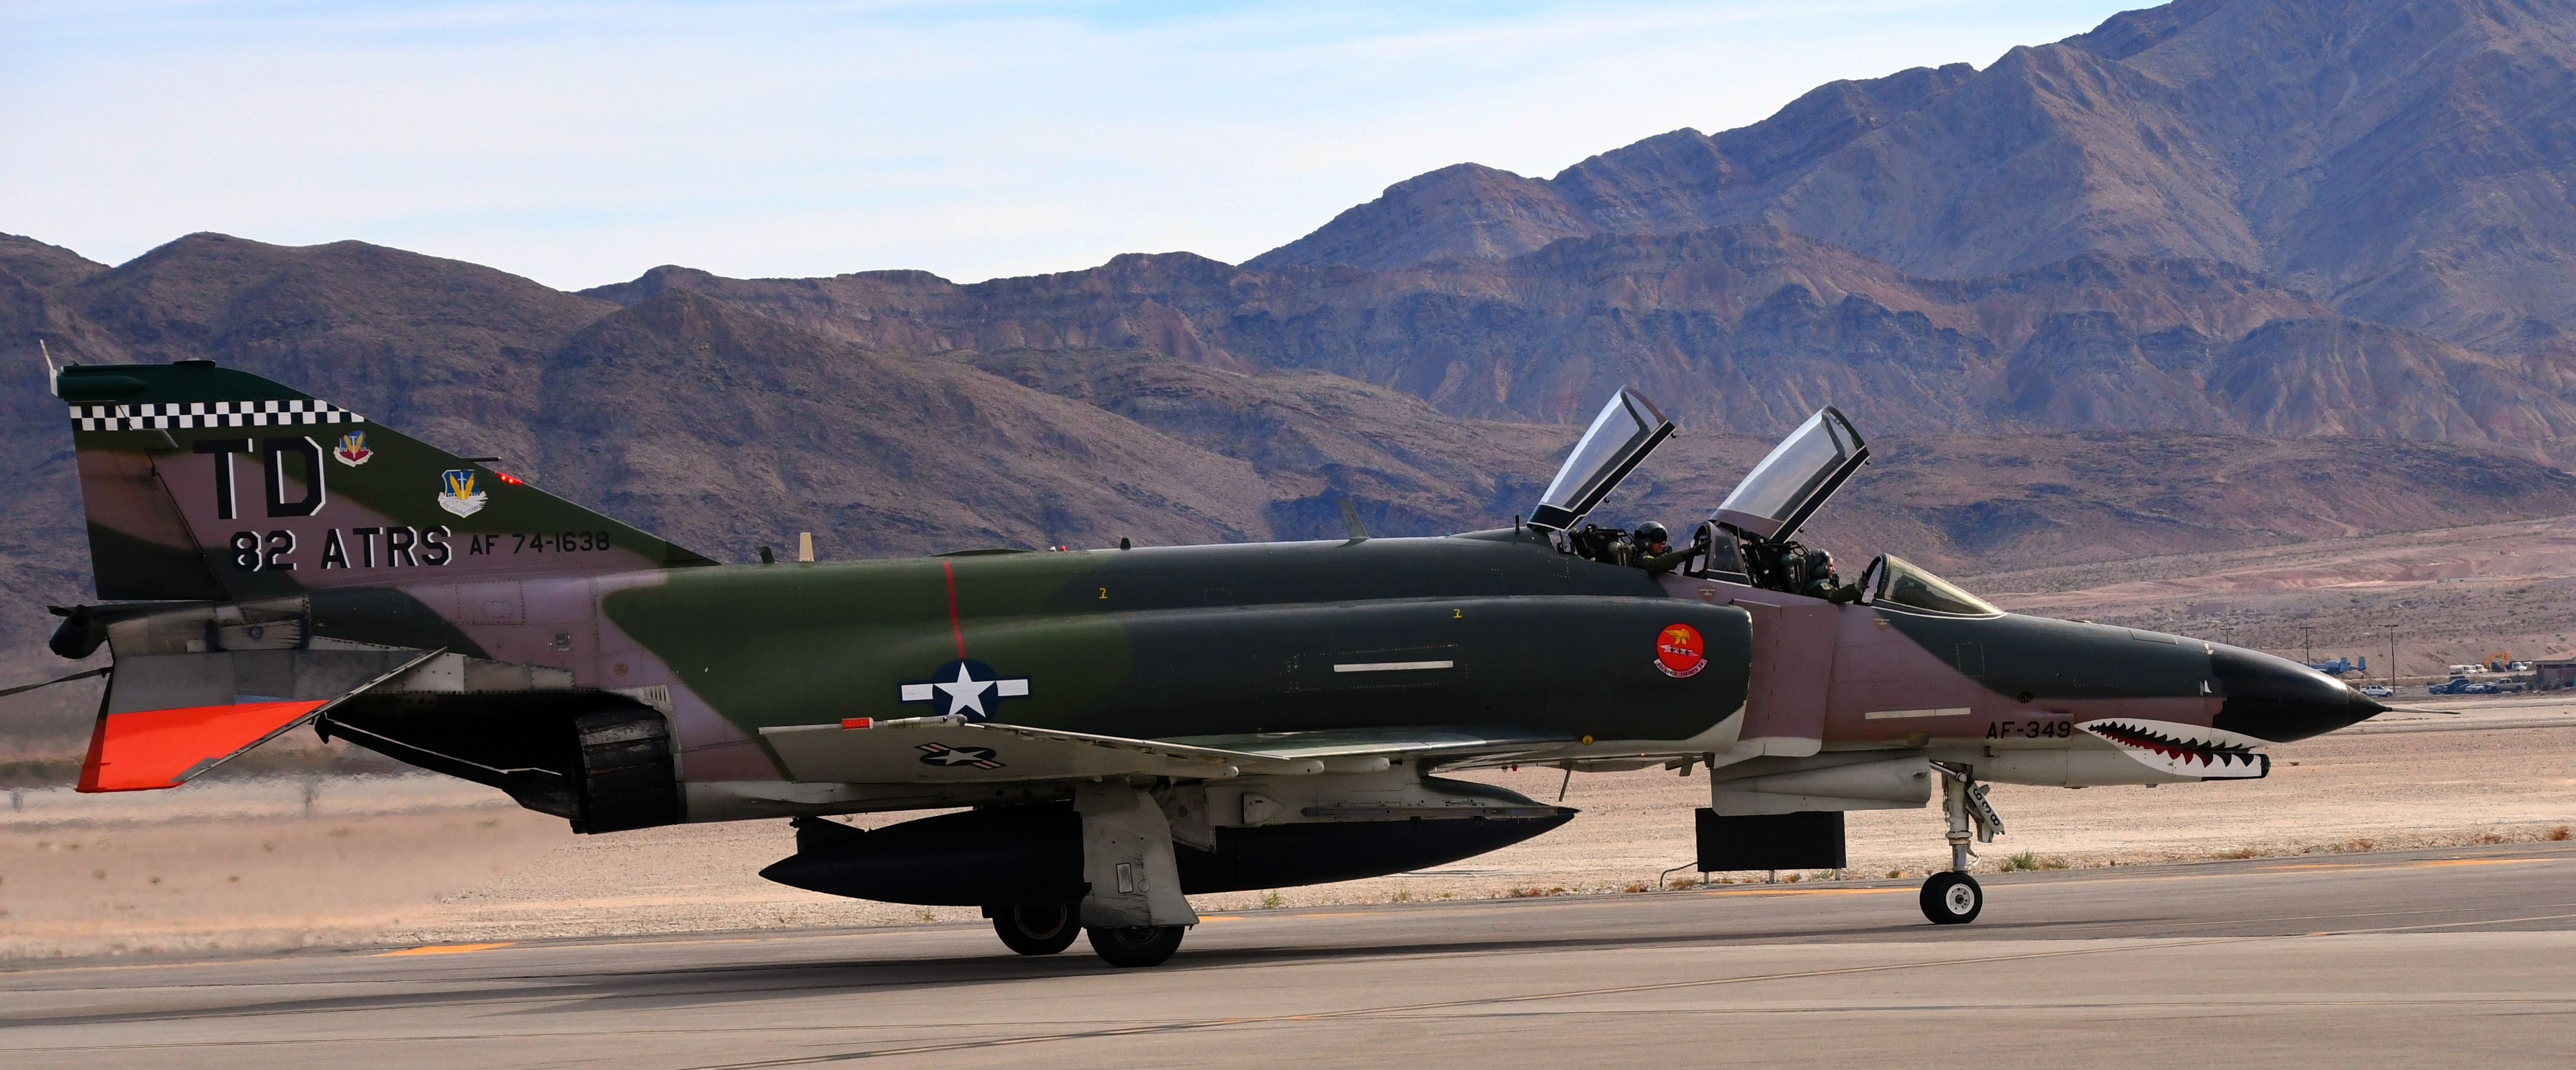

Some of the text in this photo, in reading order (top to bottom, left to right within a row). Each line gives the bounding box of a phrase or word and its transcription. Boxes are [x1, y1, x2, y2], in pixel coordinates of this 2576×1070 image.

[193, 436, 326, 520] TD
[230, 525, 452, 572] 82 ATRS
[469, 531, 610, 555] AF 74-1638
[1985, 721, 2071, 739] AF-349
[1973, 788, 2000, 826] 638
